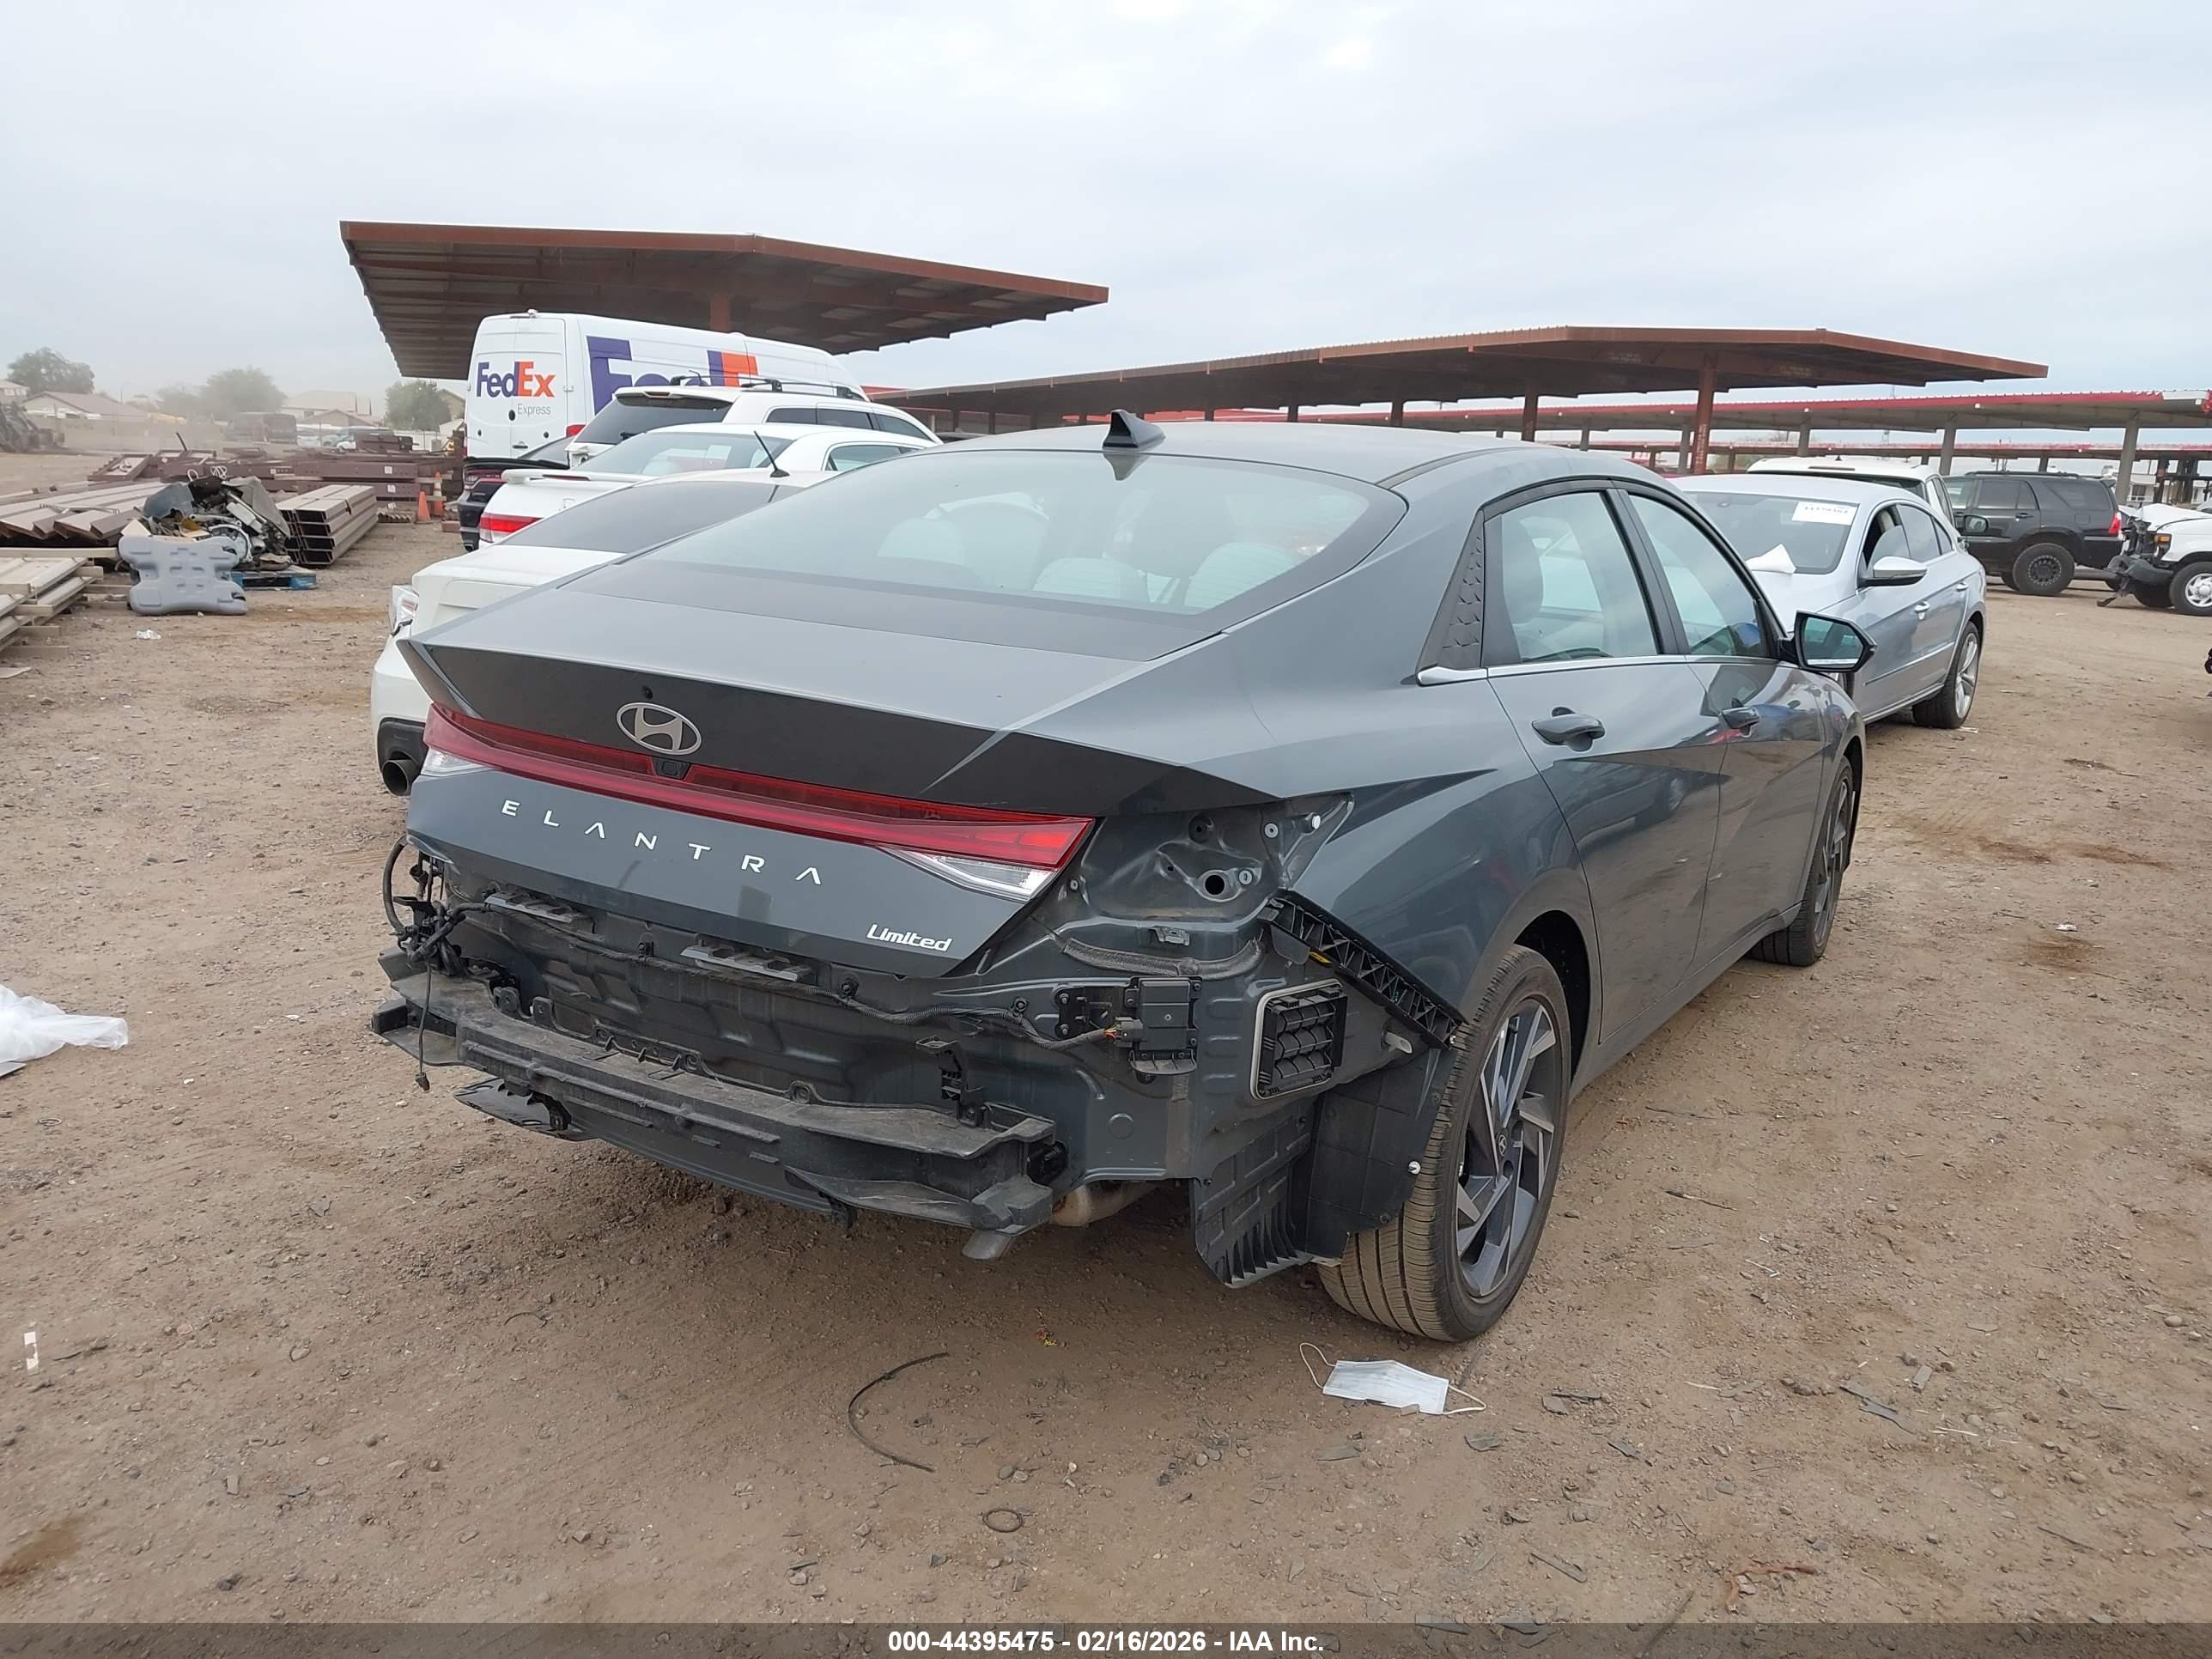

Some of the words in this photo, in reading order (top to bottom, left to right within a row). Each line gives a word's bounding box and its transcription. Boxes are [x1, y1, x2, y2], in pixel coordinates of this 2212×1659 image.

[477, 362, 556, 398] FedEx
[517, 404, 551, 417] Express
[501, 799, 823, 886] ELANTRA
[866, 923, 953, 952] Limited
